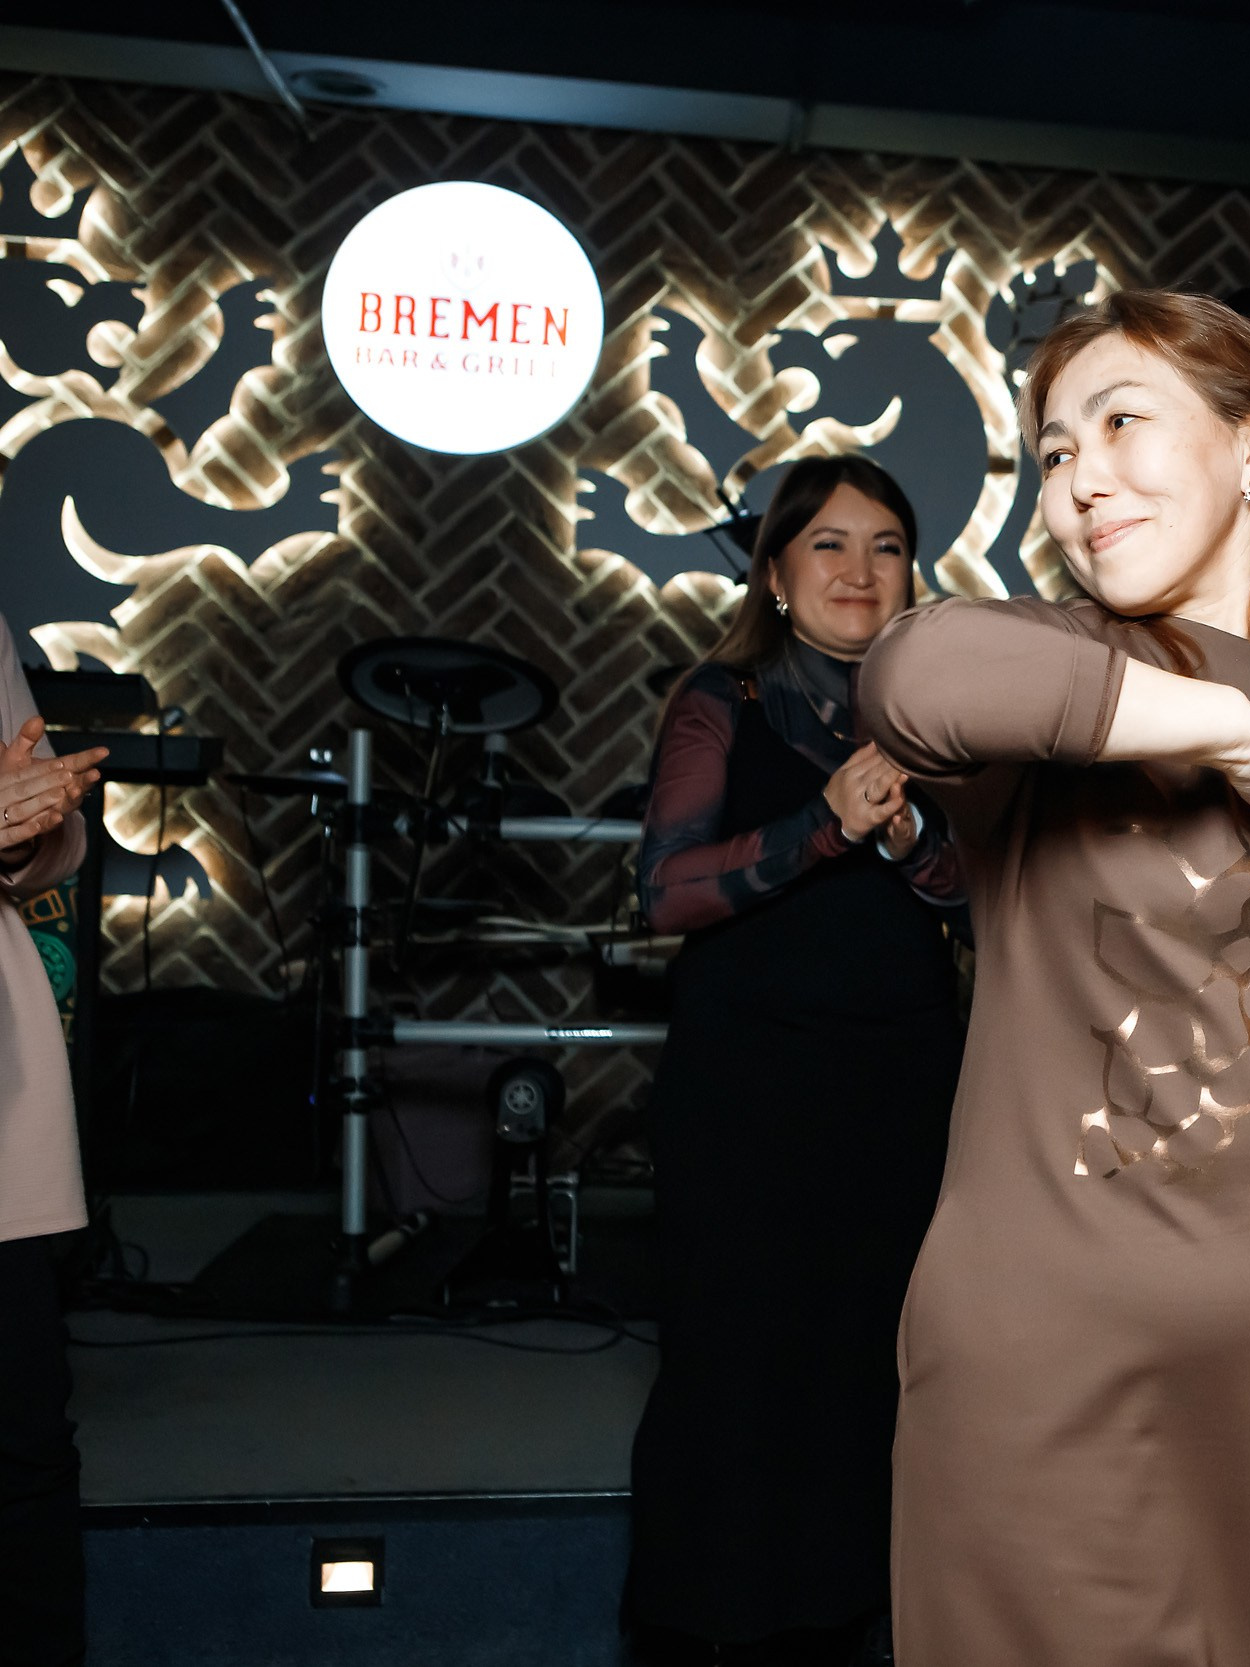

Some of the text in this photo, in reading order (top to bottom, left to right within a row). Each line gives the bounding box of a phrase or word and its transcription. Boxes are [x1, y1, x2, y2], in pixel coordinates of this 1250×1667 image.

[358, 291, 569, 347] BREMEN
[355, 346, 418, 369] BAR
[430, 351, 448, 371] &
